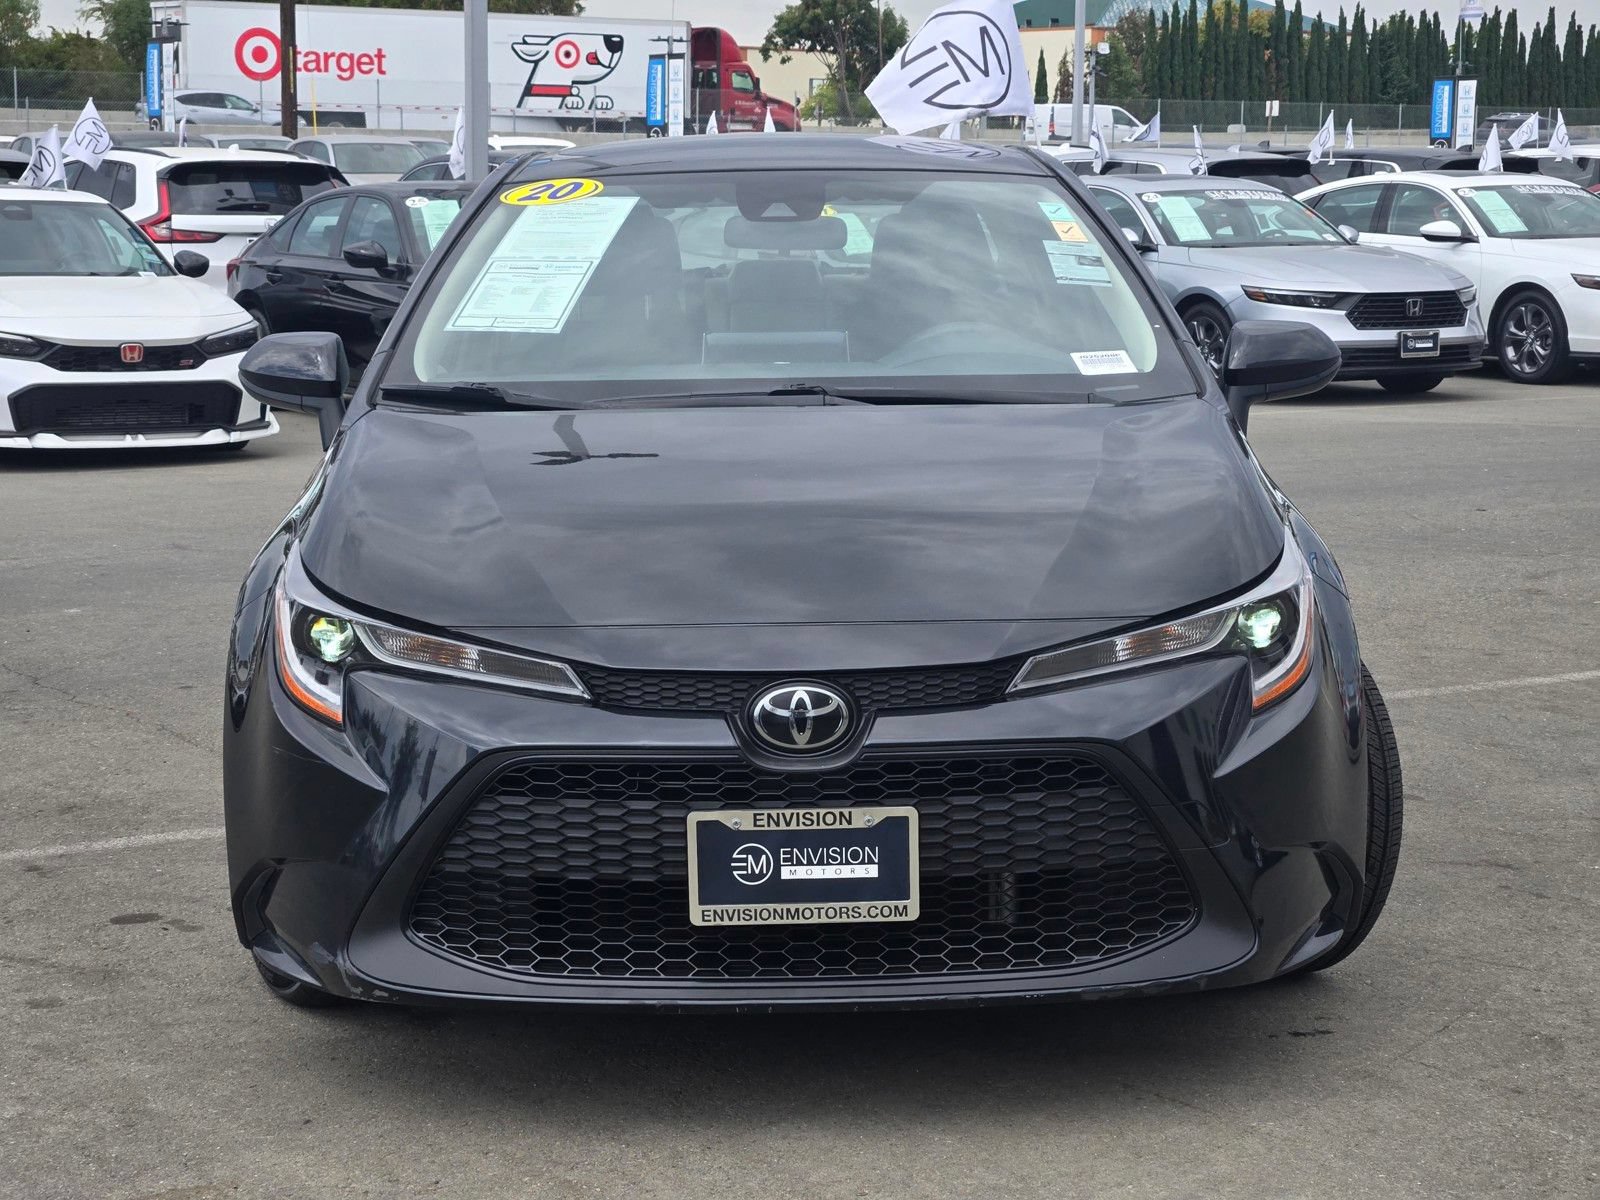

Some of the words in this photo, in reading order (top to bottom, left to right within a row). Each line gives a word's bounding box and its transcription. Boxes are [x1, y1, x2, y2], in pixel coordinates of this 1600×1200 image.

[648, 64, 658, 121] ENVISION
[1434, 85, 1445, 134] ENVISION
[516, 181, 585, 202] 20
[752, 811, 853, 828] ENVISION
[780, 846, 879, 865] ENVISION
[701, 904, 909, 923] ENVISIONMOTORS.COM
